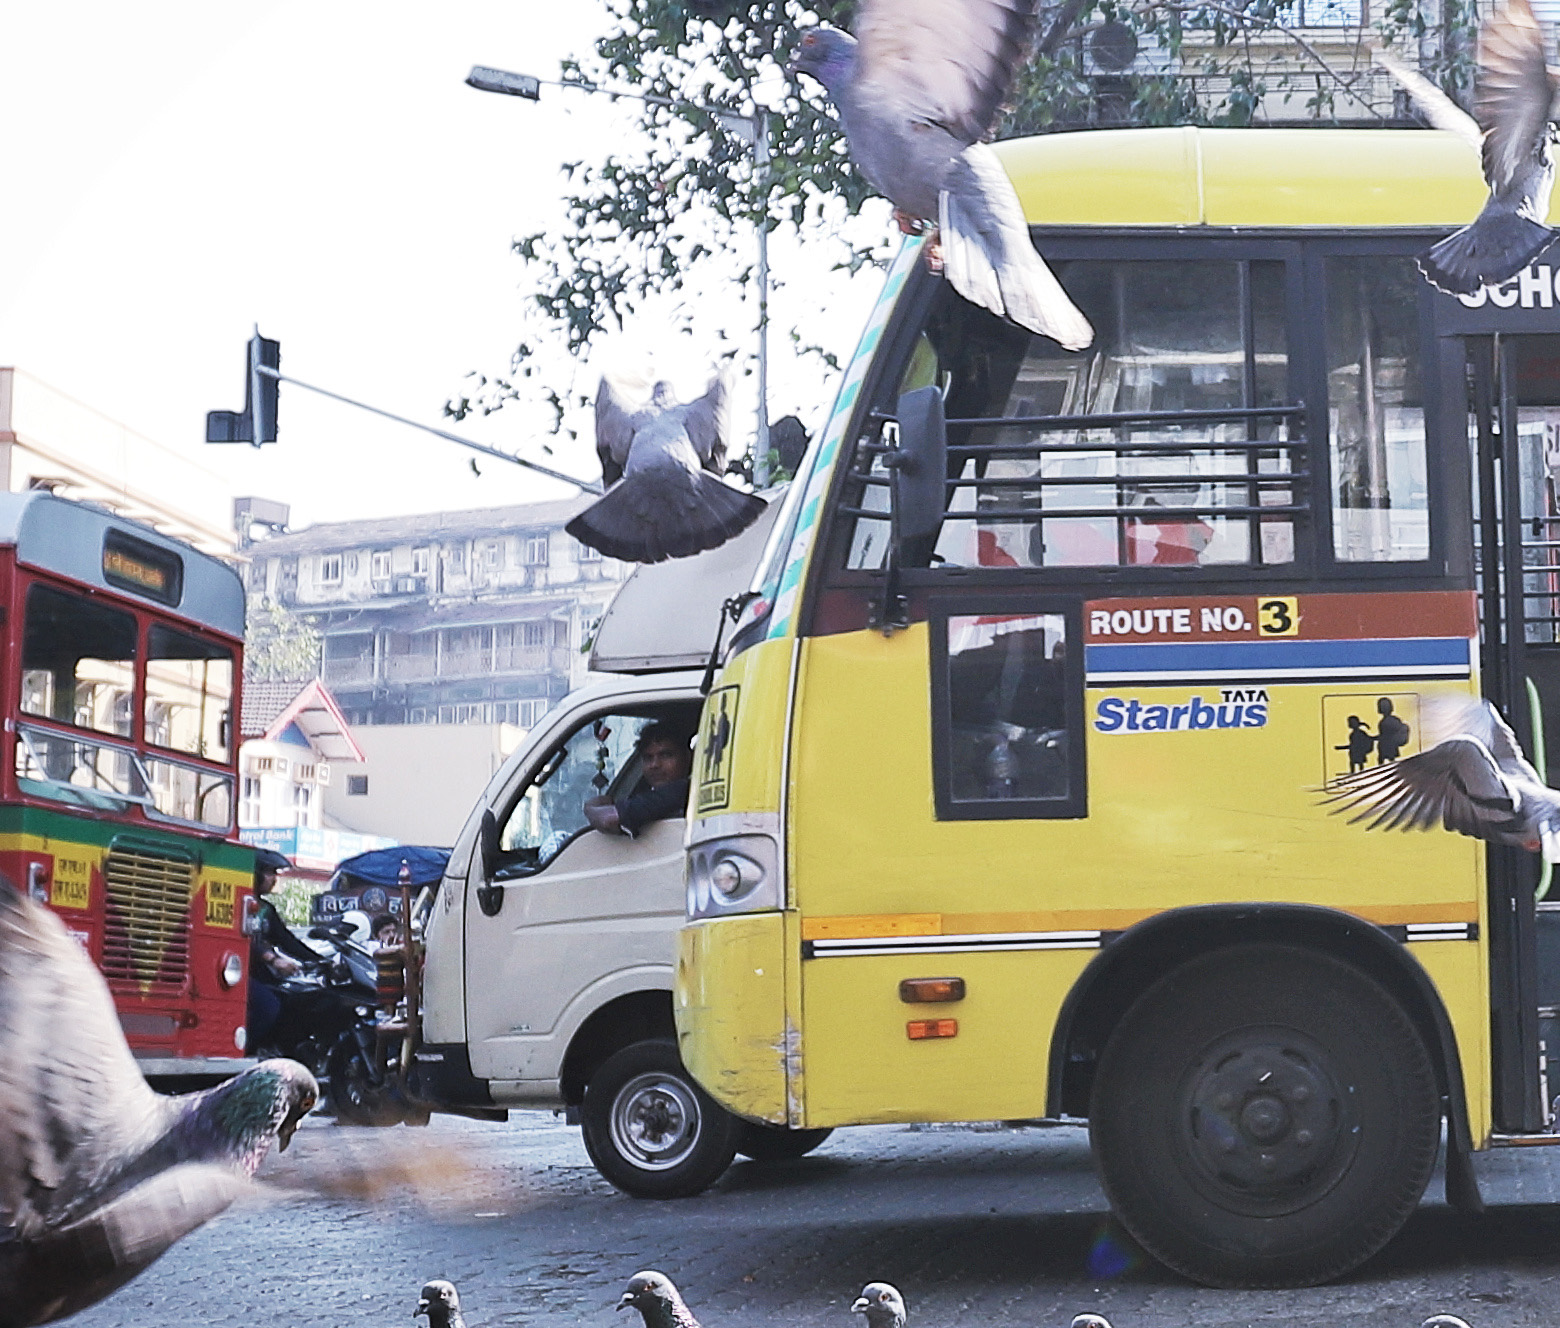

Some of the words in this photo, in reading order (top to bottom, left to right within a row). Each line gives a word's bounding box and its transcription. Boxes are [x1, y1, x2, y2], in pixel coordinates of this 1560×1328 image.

[1090, 608, 1191, 635] ROUTE
[1201, 607, 1252, 632] NO.
[1261, 600, 1292, 633] 3
[1221, 689, 1269, 703] TATA
[1094, 696, 1268, 732] Starbus
